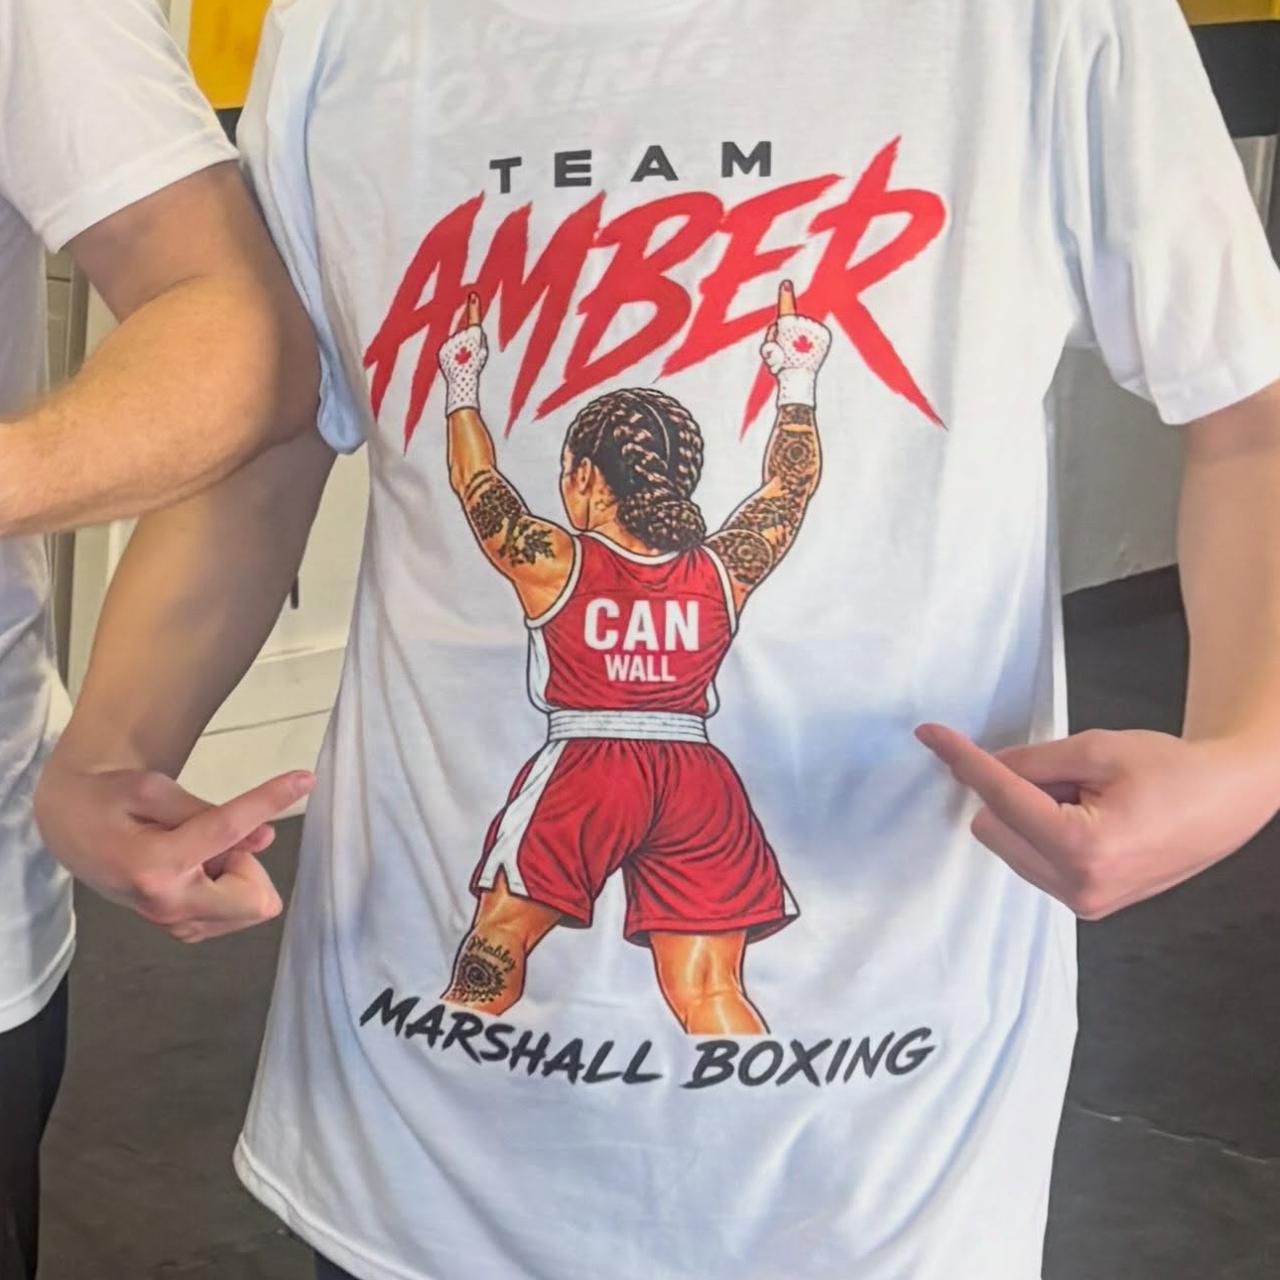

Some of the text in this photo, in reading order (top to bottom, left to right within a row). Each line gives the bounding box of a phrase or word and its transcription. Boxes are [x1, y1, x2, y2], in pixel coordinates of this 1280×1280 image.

[488, 140, 773, 195] TEAM
[362, 134, 950, 458] AMBER
[582, 596, 701, 653] CAN
[604, 653, 677, 683] WALL
[358, 986, 937, 1090] MARSHALL BOXING
